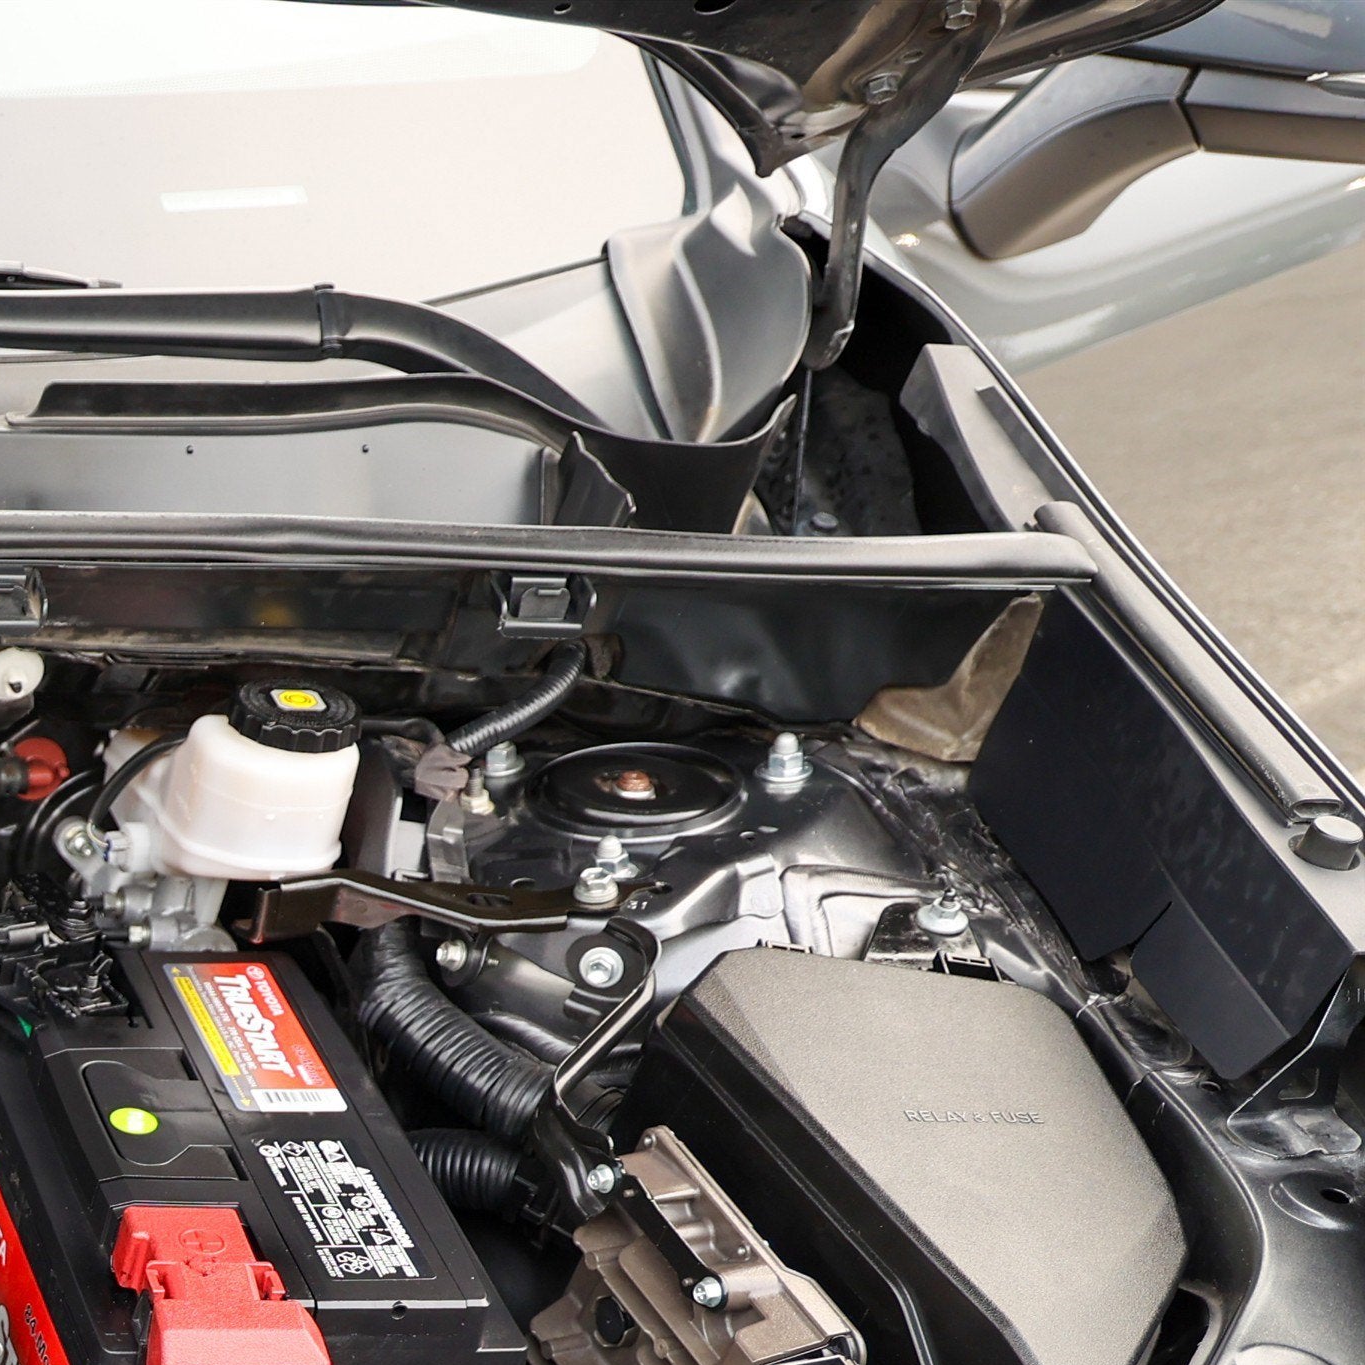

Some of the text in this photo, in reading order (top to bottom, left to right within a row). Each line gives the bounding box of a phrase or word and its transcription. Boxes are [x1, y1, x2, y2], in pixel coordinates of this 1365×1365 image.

[255, 979, 285, 1016] TOYOTA
[904, 1109, 968, 1123] RELAY
[989, 1111, 1044, 1124] FUSE
